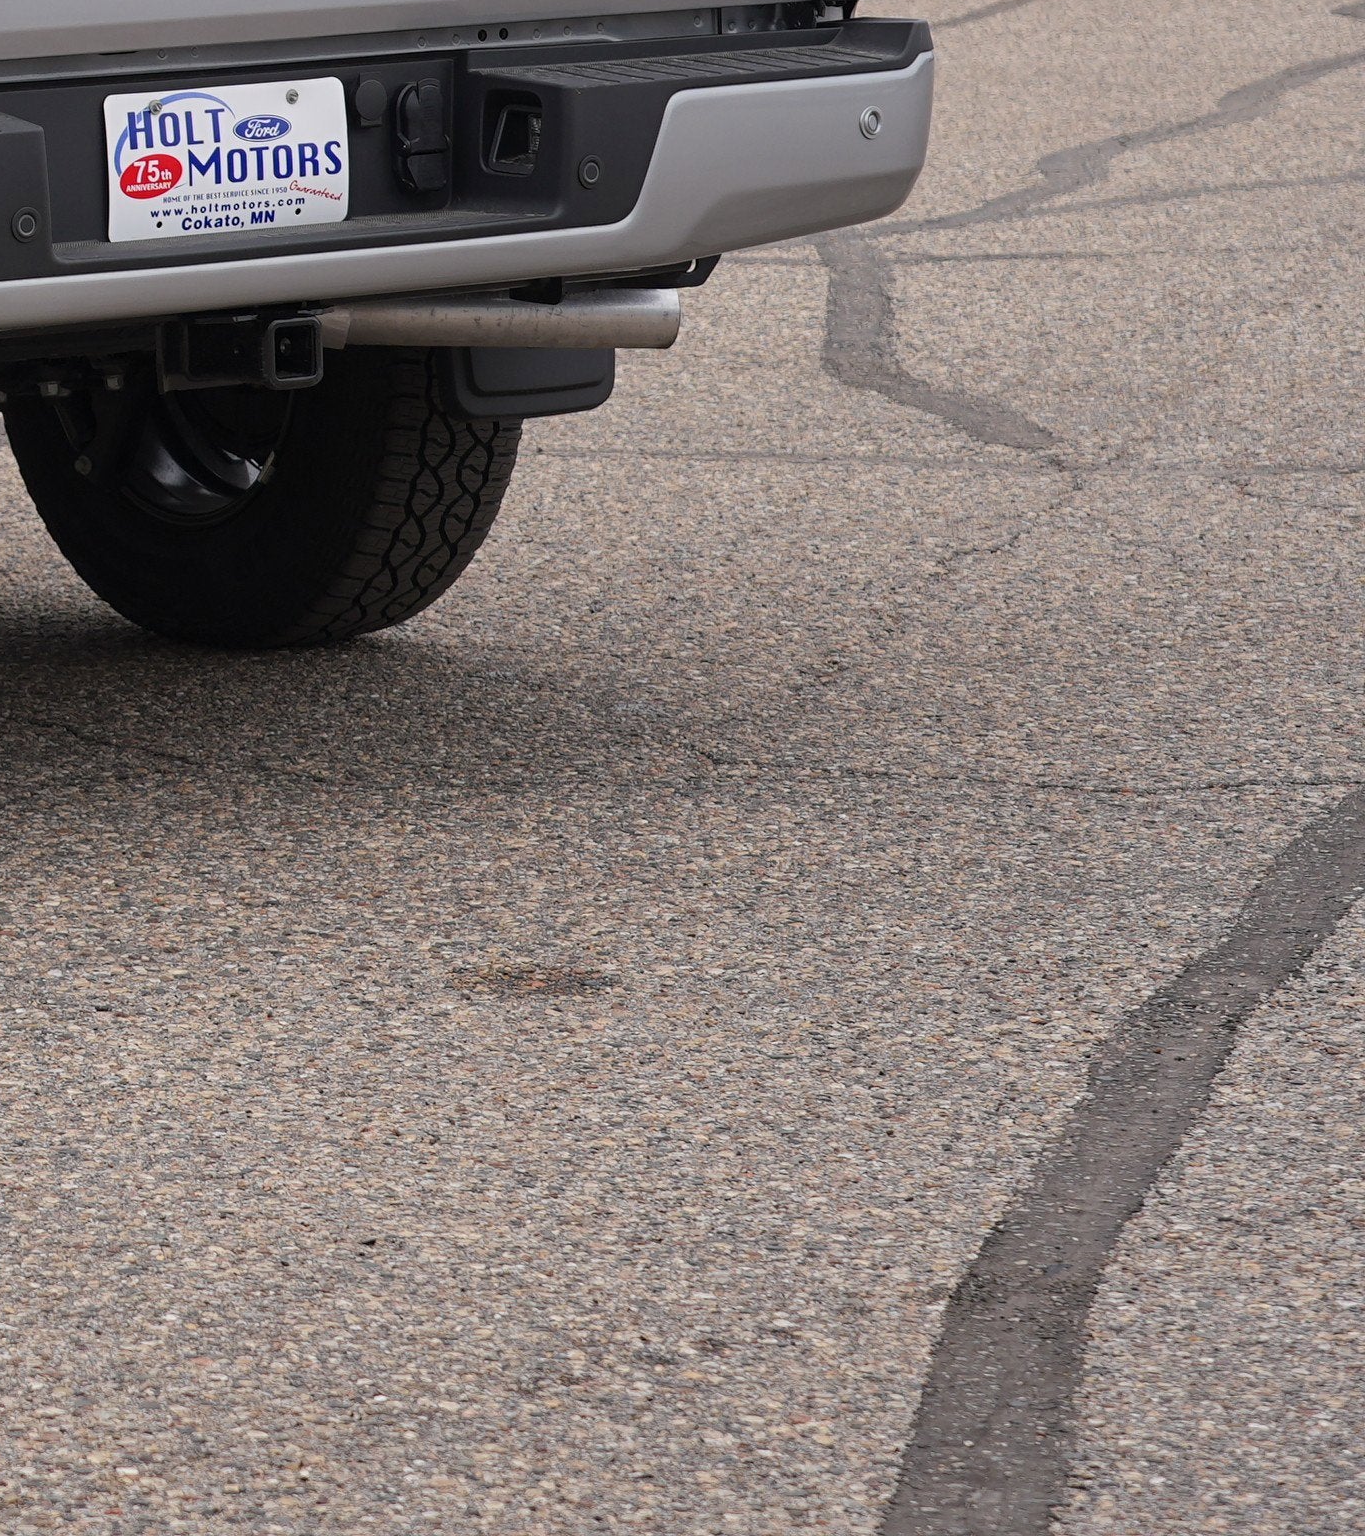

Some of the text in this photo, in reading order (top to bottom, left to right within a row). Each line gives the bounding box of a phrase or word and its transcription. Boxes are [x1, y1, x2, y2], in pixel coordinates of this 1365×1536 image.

[126, 108, 226, 150] HOLT
[244, 118, 281, 138] Ford
[132, 159, 173, 184] 75th
[187, 140, 343, 187] MOTORS
[125, 181, 172, 193] ANNIVERSARY
[163, 186, 288, 204] HOME OF THE BEST SERVICE SINCE 1950
[289, 179, 344, 201] Guaranteed
[150, 197, 305, 218] www.holtmotors.com
[181, 210, 275, 231] Cokato, MN
